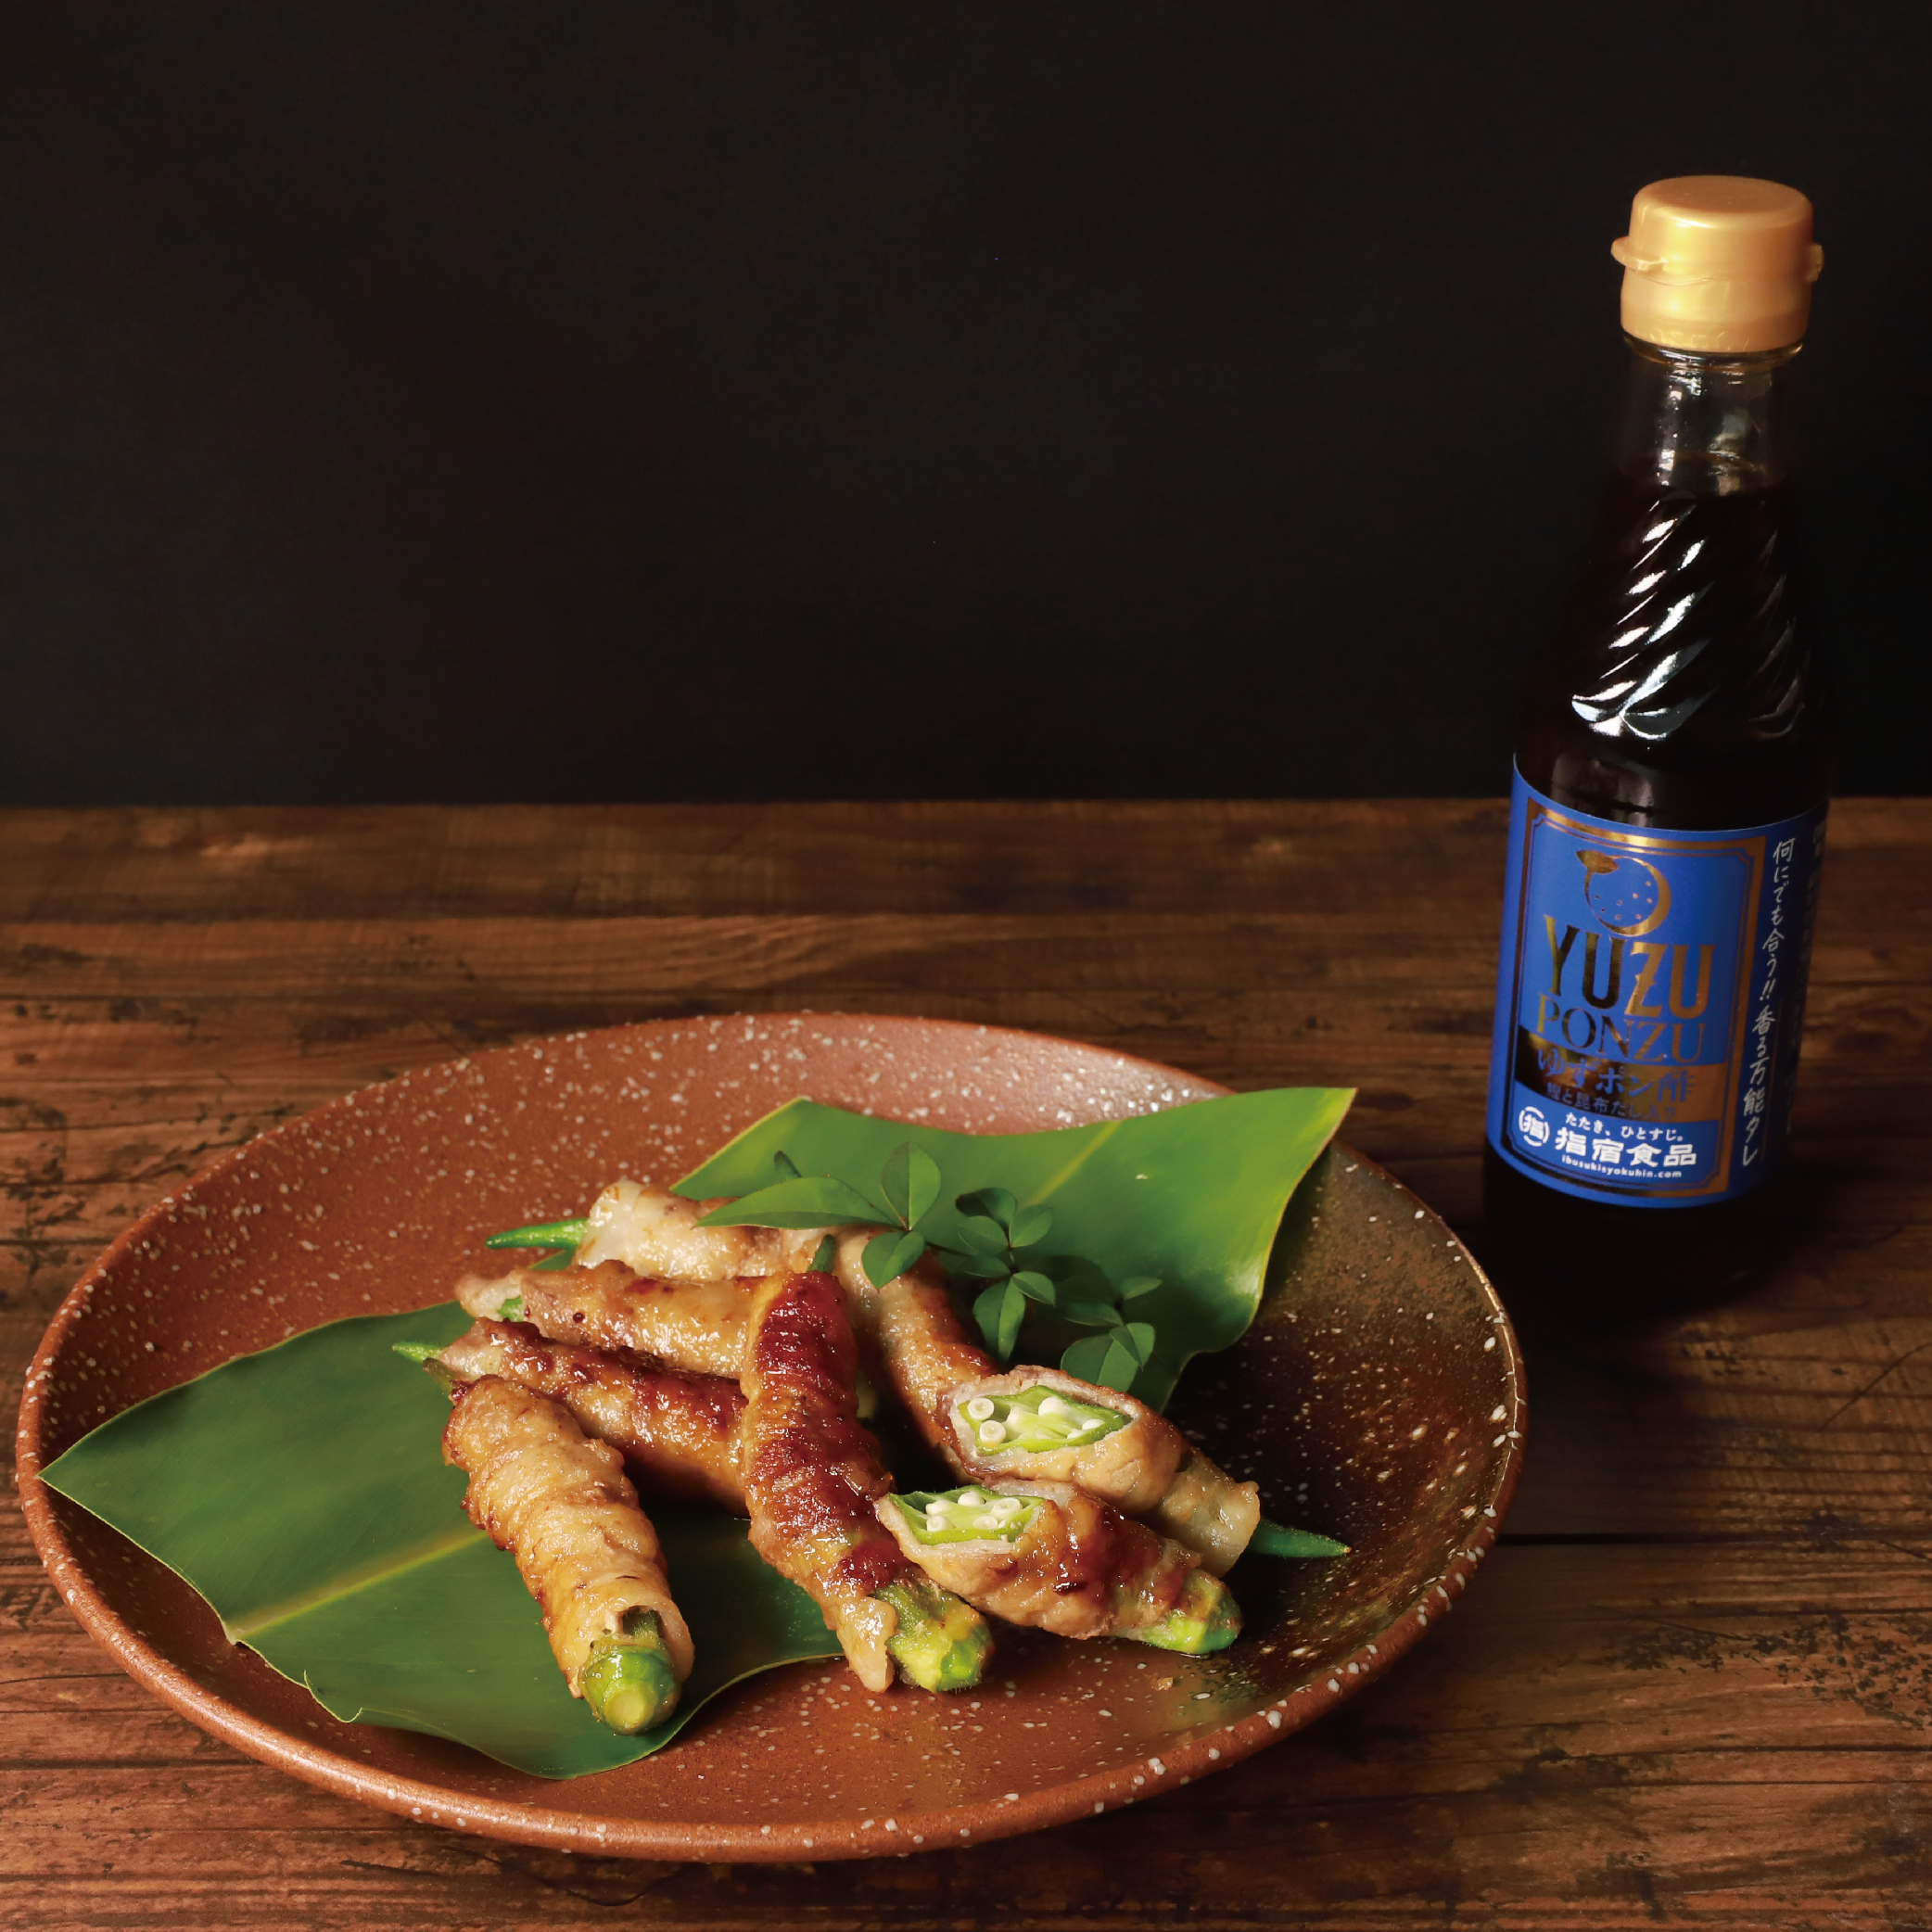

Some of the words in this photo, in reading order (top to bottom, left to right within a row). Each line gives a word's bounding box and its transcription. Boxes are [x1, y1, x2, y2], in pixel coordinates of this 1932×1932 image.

[1544, 915, 1715, 1019] YUZU
[1536, 993, 1705, 1064] PONZU
[1537, 1049, 1696, 1103] ゆずポン酢
[1555, 1126, 1697, 1167] 指宿食品
[1561, 1154, 1683, 1178] ibusukisyokuhin.com
